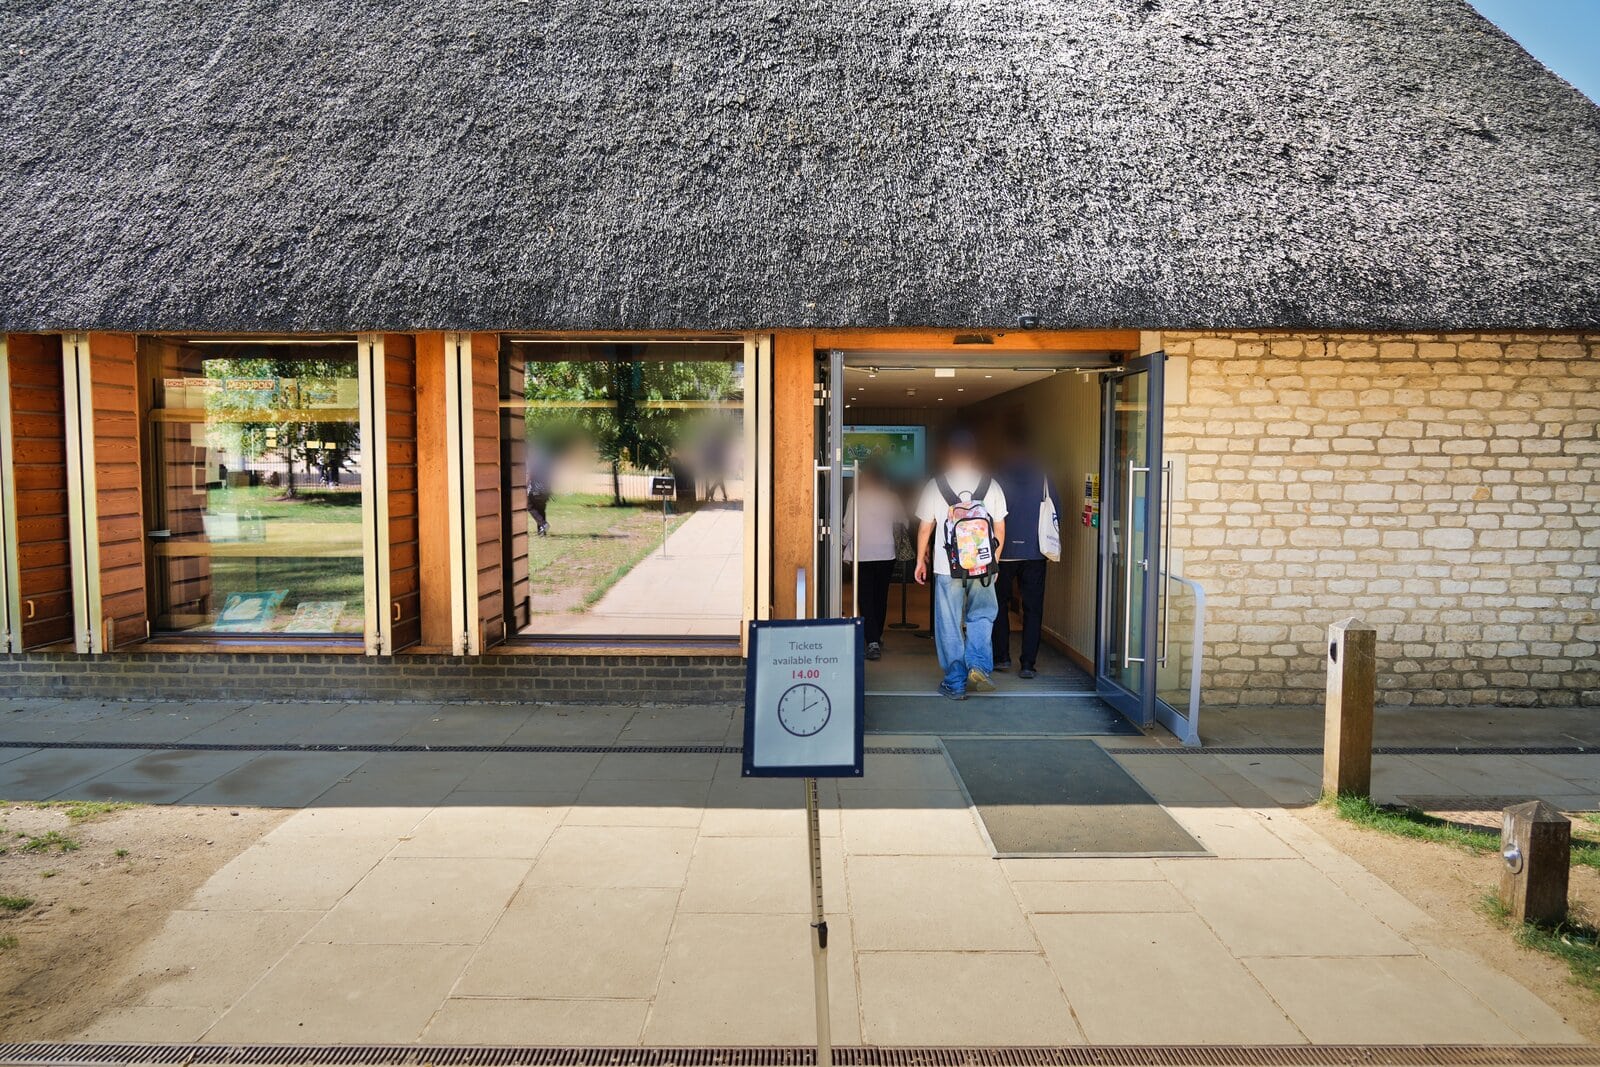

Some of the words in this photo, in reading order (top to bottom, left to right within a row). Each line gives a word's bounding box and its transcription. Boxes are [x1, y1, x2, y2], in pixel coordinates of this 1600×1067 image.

[789, 641, 823, 651] Tickets
[772, 655, 813, 666] available
[815, 654, 839, 665] from
[792, 669, 820, 680] 14.00
